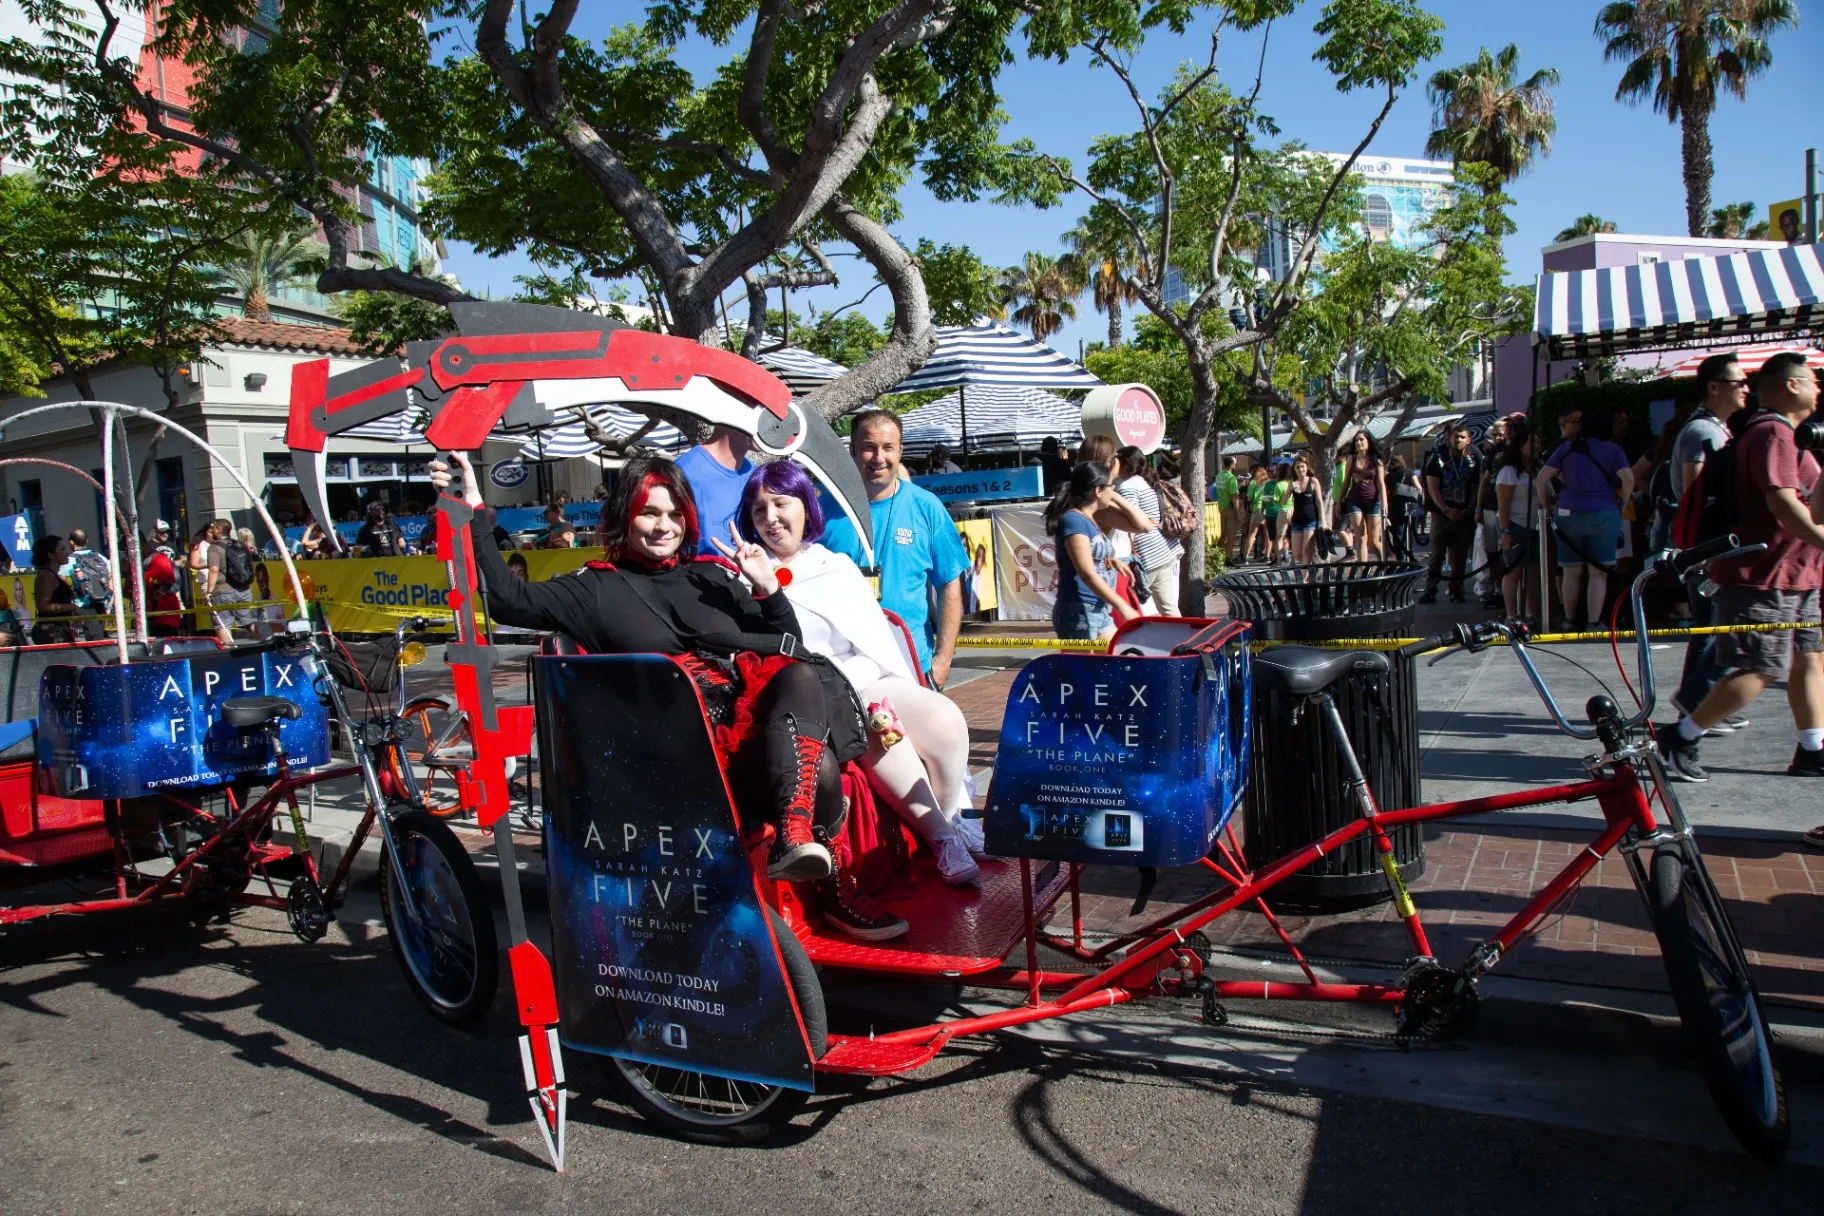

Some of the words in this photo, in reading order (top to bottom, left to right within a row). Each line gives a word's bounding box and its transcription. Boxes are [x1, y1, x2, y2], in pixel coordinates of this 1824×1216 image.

[1340, 160, 1374, 172] lton
[1115, 408, 1135, 423] GOOD
[1136, 409, 1158, 424] PLATES
[1003, 480, 1012, 491] 2
[14, 516, 31, 551] ATM
[374, 571, 398, 586] The
[361, 584, 407, 606] Good
[159, 664, 294, 700] APEX
[44, 685, 85, 700] APEX
[1019, 682, 1148, 707] APEX
[1030, 711, 1081, 719] SARAH
[1094, 713, 1134, 721] KATZ
[1027, 721, 1139, 747] FIVE
[1049, 764, 1078, 773] BOOK
[148, 775, 199, 789] DOWNLOAD
[1040, 784, 1091, 794] DOWNLOAD
[1093, 787, 1123, 795] TODAY
[1037, 794, 1051, 802] ON
[1052, 796, 1089, 805] AMAZON
[1090, 798, 1126, 807] KINDLE!
[1051, 813, 1092, 824] APEX
[584, 820, 714, 860] APEX
[595, 860, 648, 873] SARAH
[661, 866, 702, 878] KATZ
[594, 874, 708, 915] FIVE
[598, 963, 673, 984] DOWNLOAD
[675, 974, 719, 993] TODAY
[595, 984, 615, 998] ON
[617, 988, 672, 1007] AMAZON
[674, 996, 725, 1017] KINDLE!
